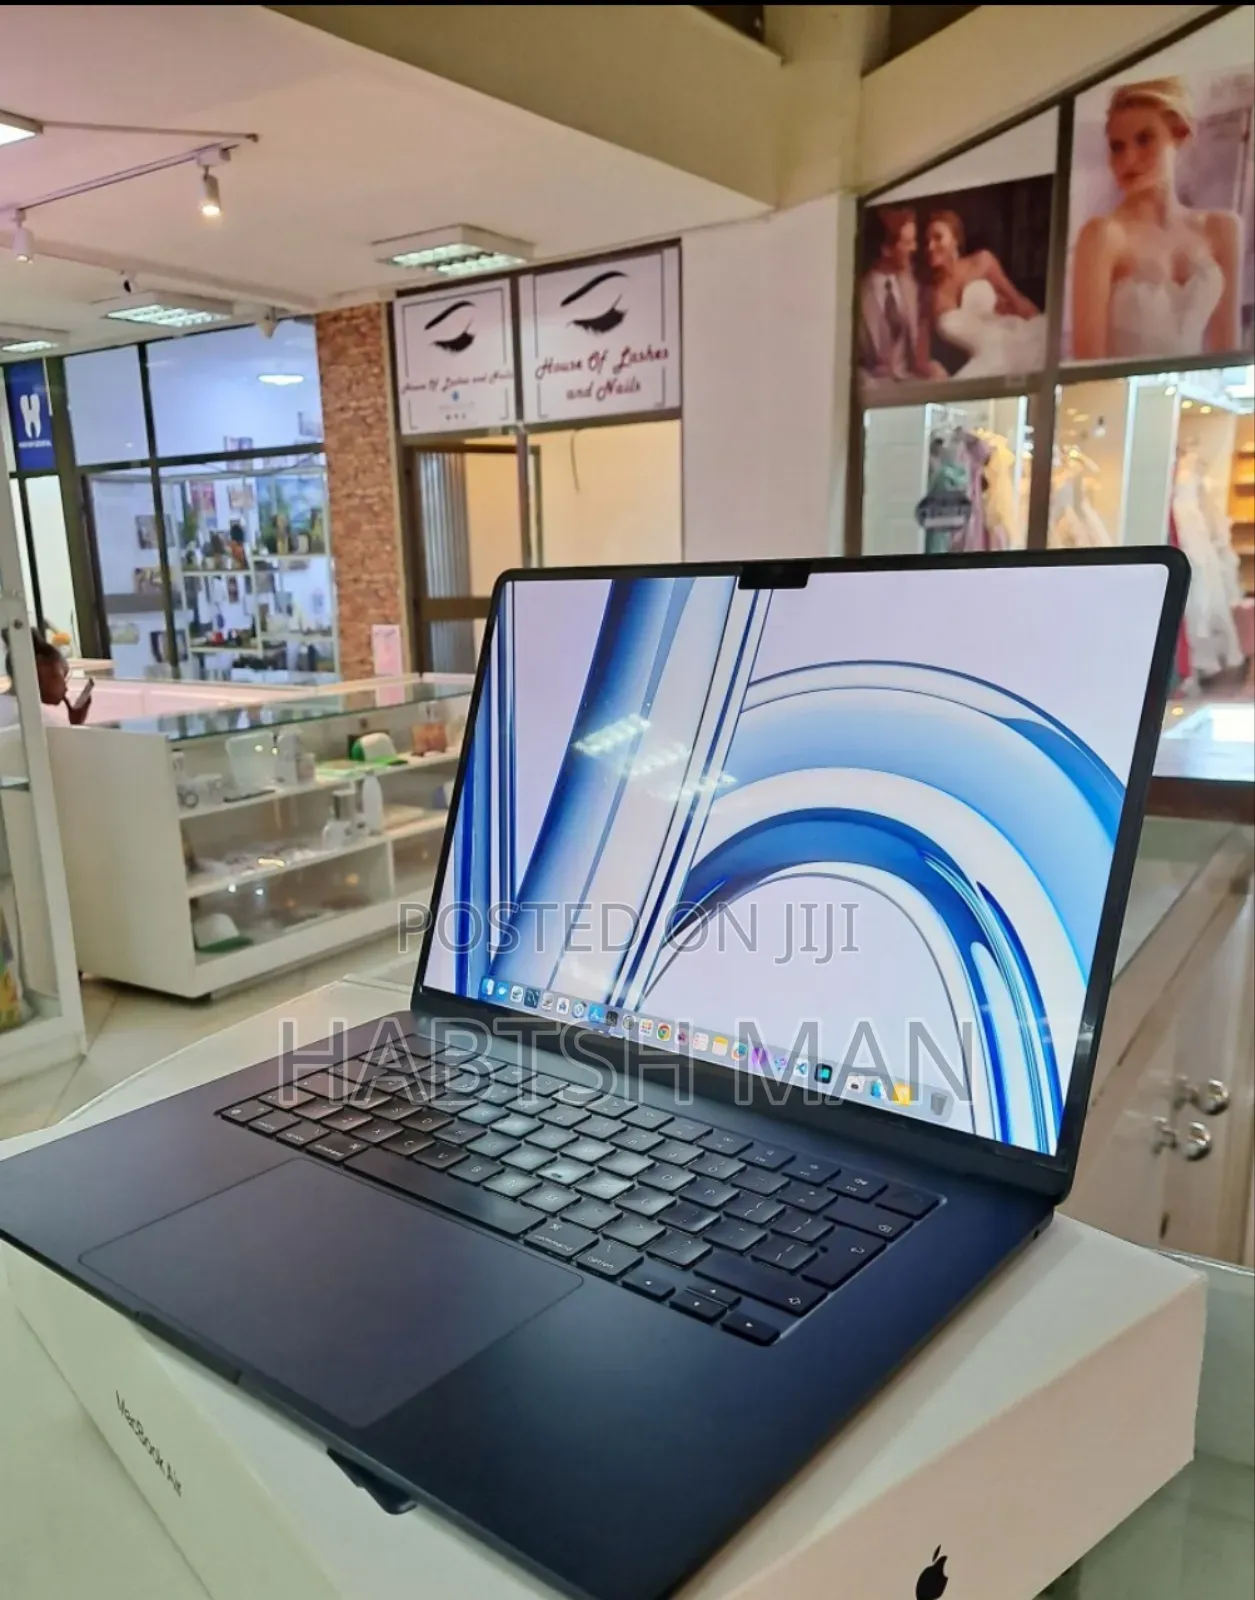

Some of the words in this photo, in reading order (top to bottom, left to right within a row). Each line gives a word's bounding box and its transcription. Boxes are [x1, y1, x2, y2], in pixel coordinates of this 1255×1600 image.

[535, 358, 582, 380] House
[588, 349, 609, 374] Of
[612, 345, 669, 375] Lashes
[566, 381, 594, 400] and
[596, 376, 641, 402] Nails
